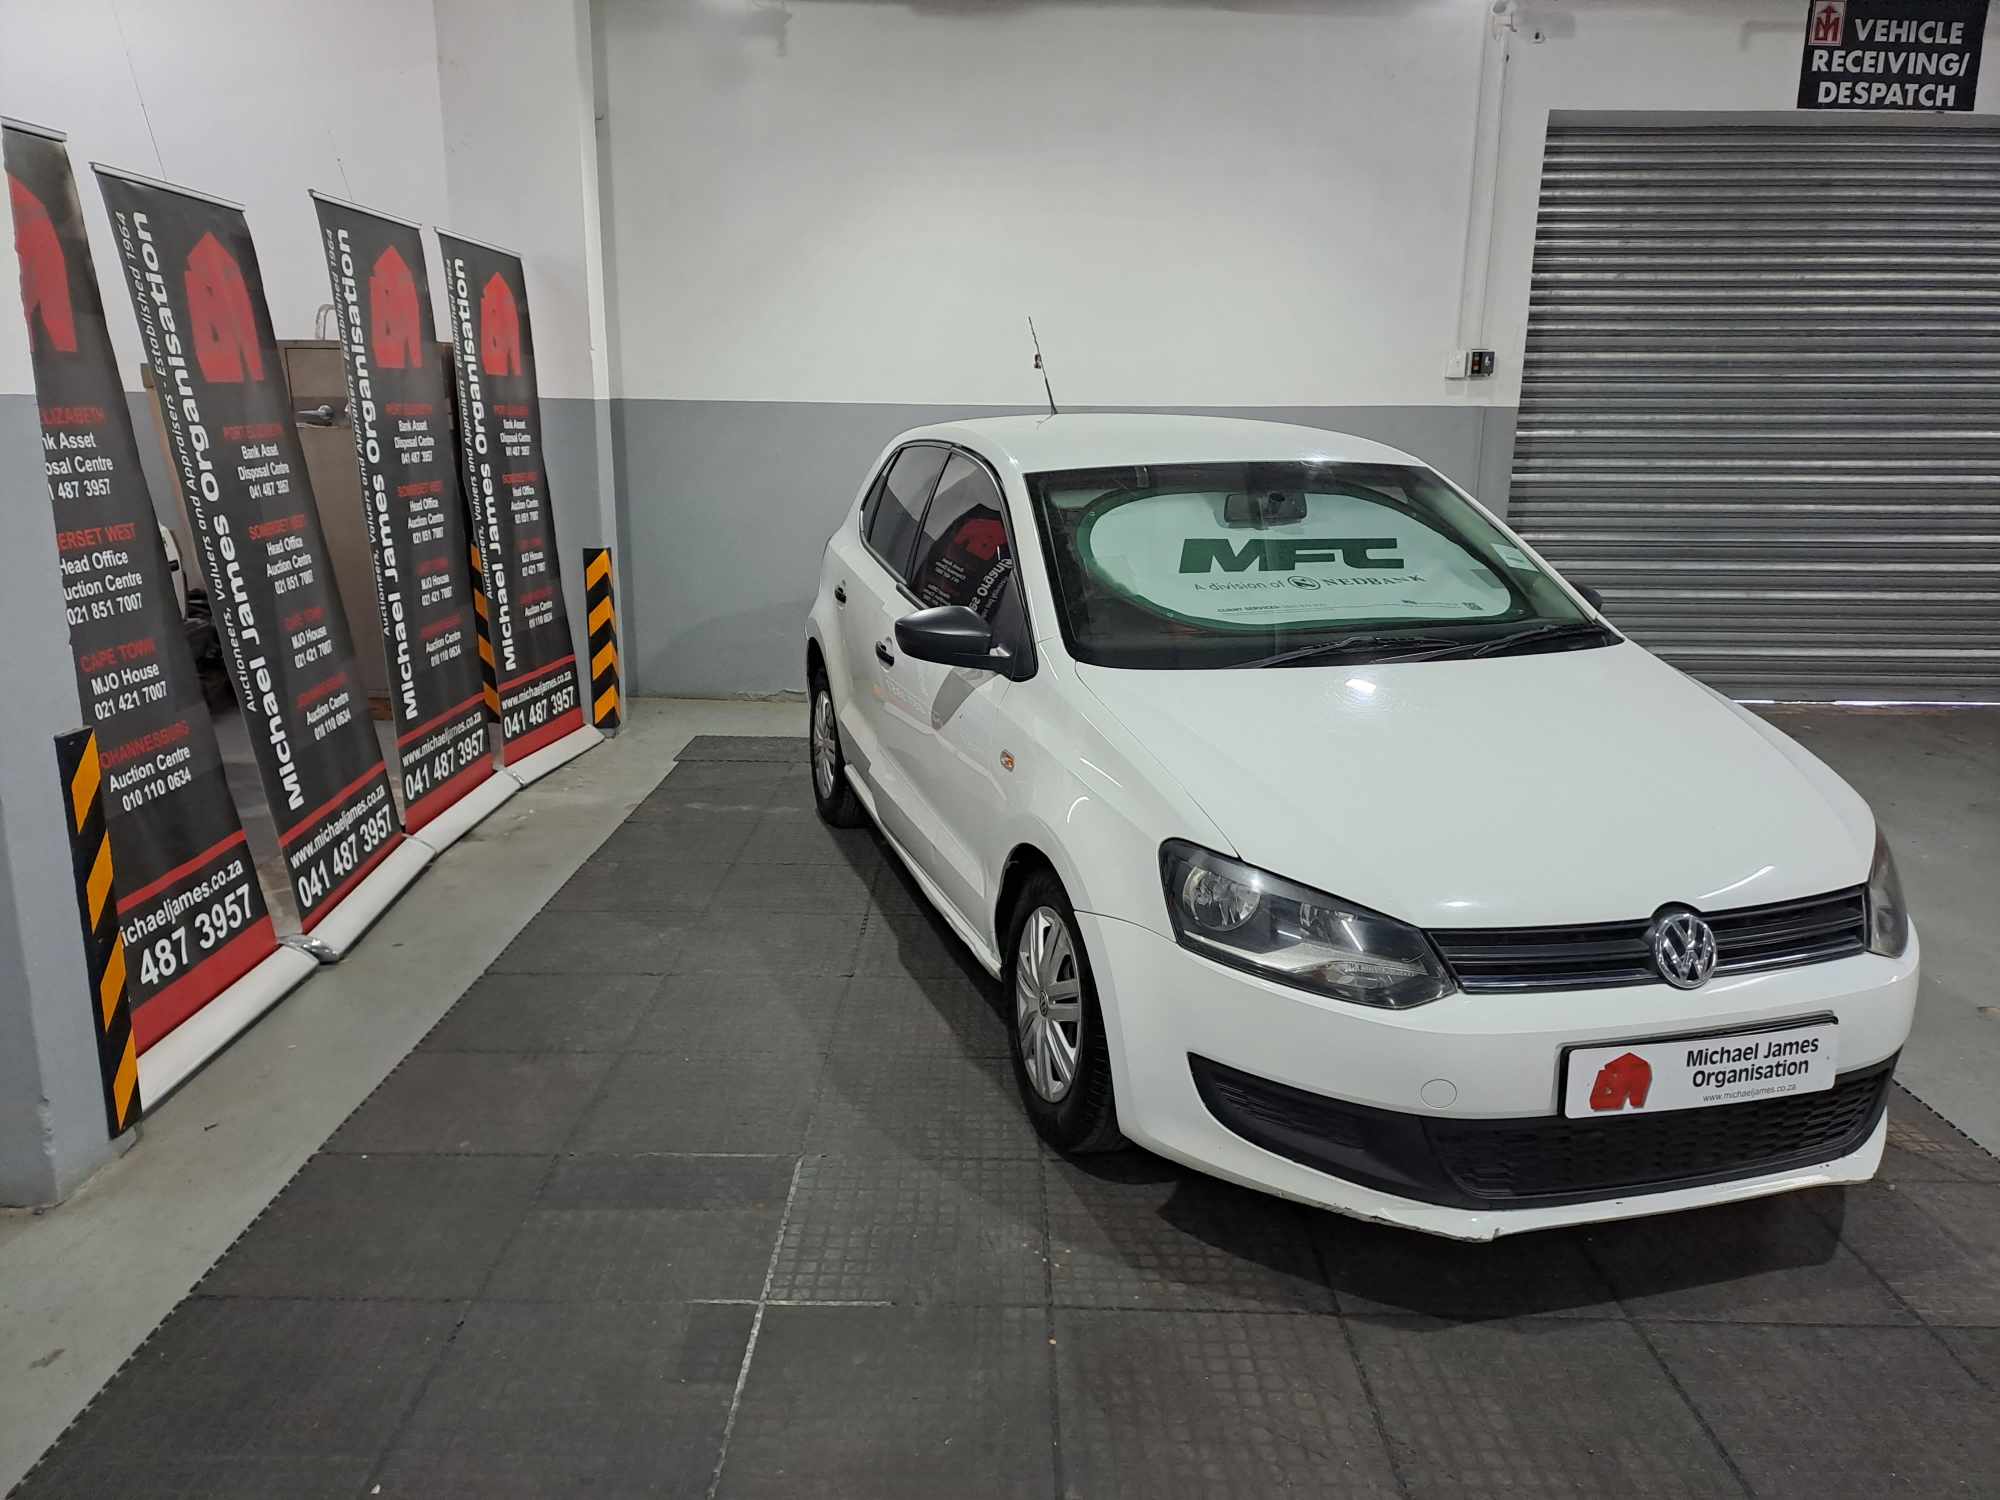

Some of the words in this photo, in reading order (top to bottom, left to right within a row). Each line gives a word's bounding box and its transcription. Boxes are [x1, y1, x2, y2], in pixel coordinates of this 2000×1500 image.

[1854, 18, 1965, 44] VEHICLE
[1811, 50, 1970, 77] RECEIVING/
[1817, 81, 1956, 106] DESPATCH
[115, 211, 137, 260] 1964
[129, 265, 166, 376] Established
[132, 212, 220, 501] Organisation
[337, 228, 380, 463] Organisation
[454, 258, 487, 454] Organisation
[60, 432, 96, 449] Asset
[166, 393, 197, 490] Appraisers
[74, 456, 113, 472] Centre
[58, 481, 80, 499] 487
[83, 479, 111, 496] 3957
[480, 463, 501, 555] James
[187, 496, 207, 530] and
[372, 474, 399, 583] James
[91, 550, 128, 569] Office
[202, 534, 227, 600] Valuers
[266, 560, 293, 577] Auction
[1179, 538, 1404, 574] MFC
[105, 571, 143, 591] Centre
[213, 514, 260, 645] James
[1193, 582, 1206, 591] A
[1208, 581, 1267, 591] division
[1269, 579, 1286, 589] of
[1321, 574, 1428, 587] NEDBANK
[66, 605, 89, 626] 021
[91, 599, 115, 619] 851
[116, 592, 143, 613] 7007
[492, 562, 517, 672] Michael
[223, 607, 257, 712] Auctioneers,
[388, 592, 418, 720] Michael
[91, 672, 119, 696] MJO
[121, 664, 160, 685] House
[94, 698, 116, 720] 021
[119, 690, 140, 711] 421
[142, 680, 167, 703] 7007
[249, 656, 304, 810] Michael
[504, 708, 526, 738] 041
[529, 698, 547, 725] 487
[551, 685, 574, 715] 3957
[110, 764, 155, 793] Auction
[157, 747, 191, 770] Centre
[405, 763, 430, 800] 041
[433, 747, 454, 781] 487
[457, 728, 484, 765] 3957
[122, 789, 143, 812] 010
[144, 779, 166, 800] 110
[167, 766, 192, 791] 0634
[290, 784, 386, 869] www.michaeljames.co.za
[298, 858, 330, 908] 041
[333, 833, 359, 876] 487
[360, 804, 392, 852] 3957
[140, 926, 188, 985] 487
[194, 883, 252, 949] 3957
[1686, 1043, 1758, 1067] Michael
[1763, 1037, 1819, 1059] James
[1692, 1058, 1809, 1088] Organisation
